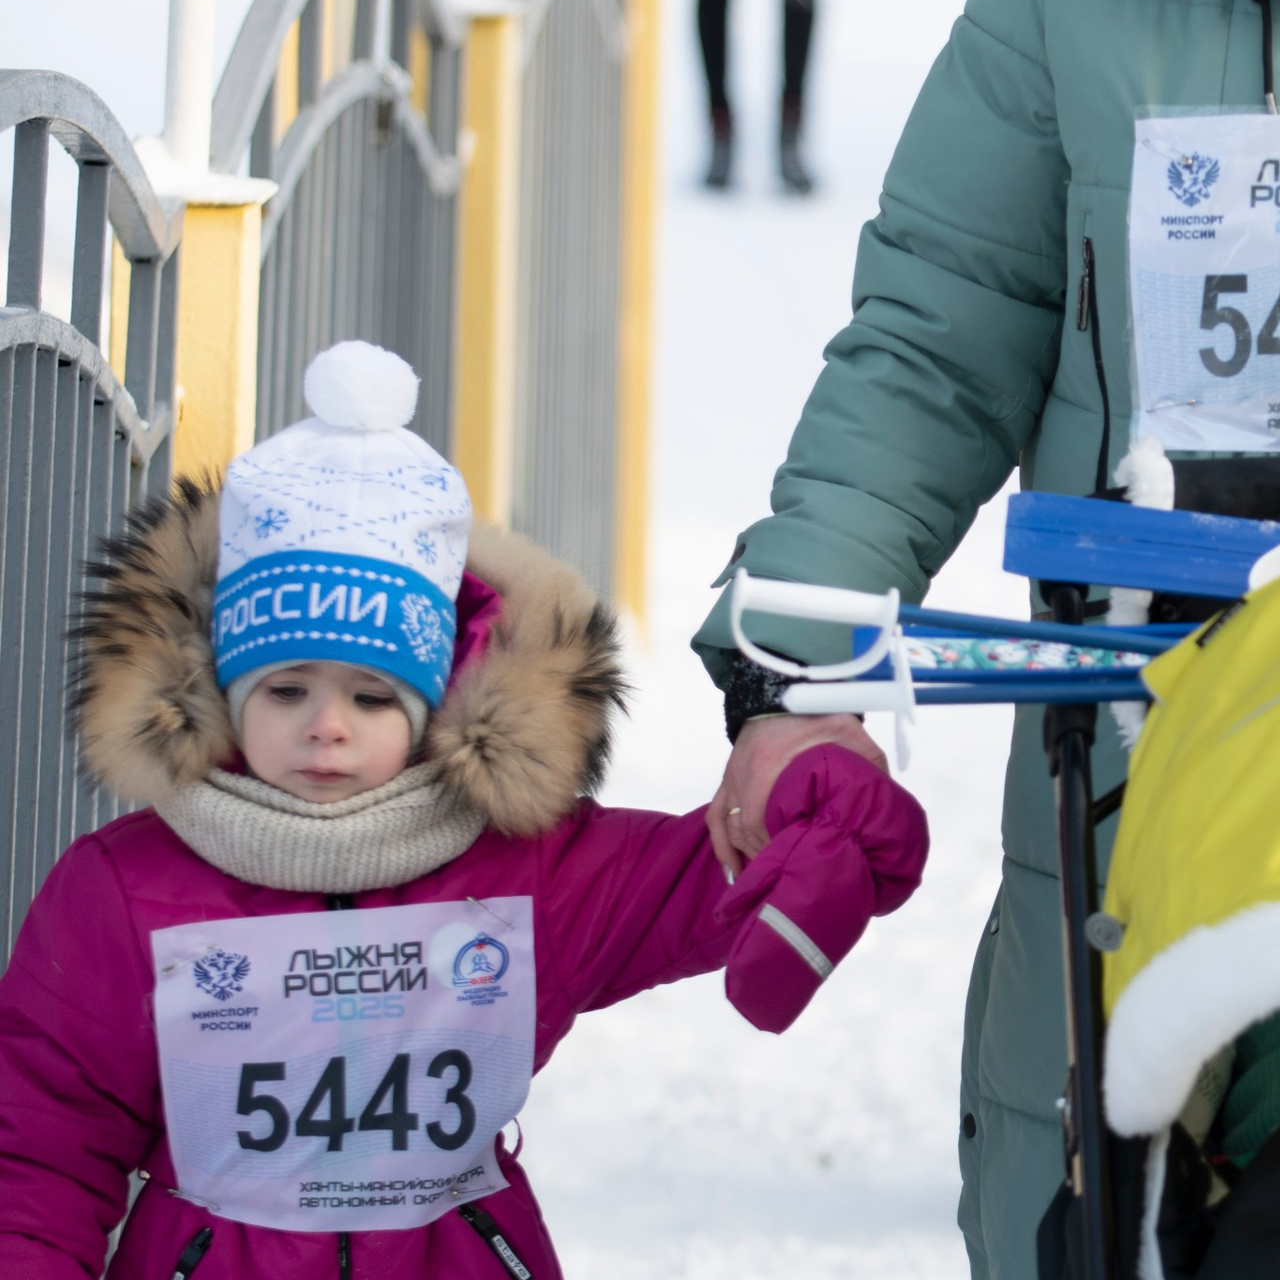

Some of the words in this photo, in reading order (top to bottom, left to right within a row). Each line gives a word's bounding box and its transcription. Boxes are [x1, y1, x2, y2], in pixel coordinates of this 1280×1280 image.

[1161, 215, 1224, 227] МИНСПОРТ
[1167, 229, 1216, 240] РОССИИ
[218, 582, 388, 647] РОССИИ
[289, 941, 423, 972] ЛЫЖНЯ
[283, 967, 427, 998] РОССИИ
[192, 1007, 260, 1020] МИНСПОРТ
[312, 995, 405, 1023] 2025
[201, 1021, 252, 1032] РОССИИ
[236, 1049, 476, 1153] 5443
[299, 1193, 405, 1208] АВТОНОМНЫЙ
